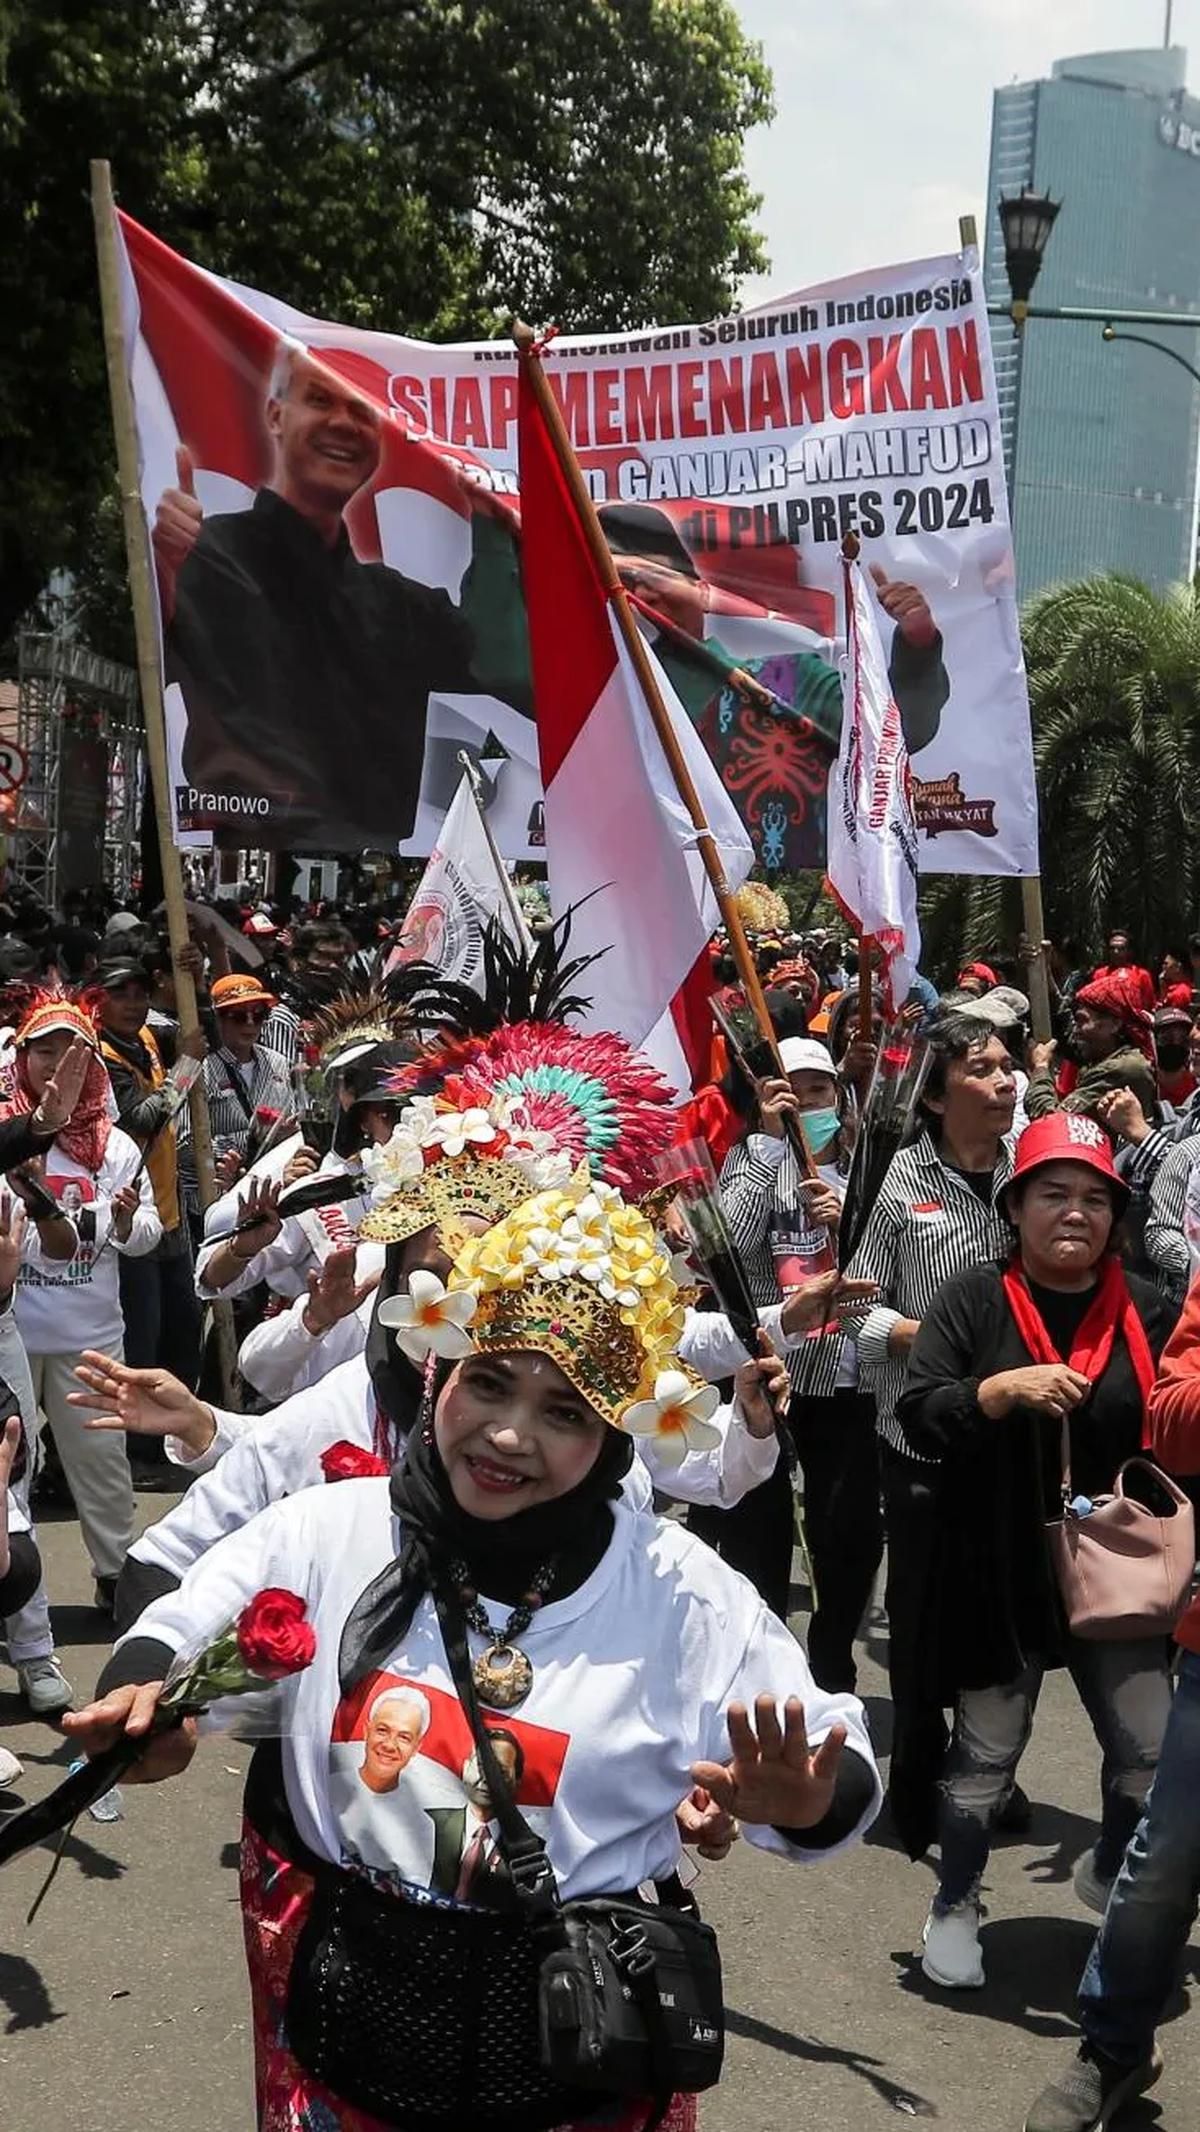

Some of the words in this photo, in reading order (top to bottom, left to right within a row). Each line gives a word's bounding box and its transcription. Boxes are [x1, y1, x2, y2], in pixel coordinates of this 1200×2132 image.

[698, 304, 819, 346] Seluruh
[826, 278, 974, 328] Indonesia
[390, 374, 518, 450] SIAP
[546, 317, 985, 448] MEMENANGKAN
[617, 418, 993, 501] GANJAR-MAHFUD
[680, 508, 718, 553] di
[729, 492, 886, 551] PILPRES
[894, 477, 995, 536] 2024
[188, 787, 270, 816] Pranowo
[868, 769, 893, 829] GANJAR
